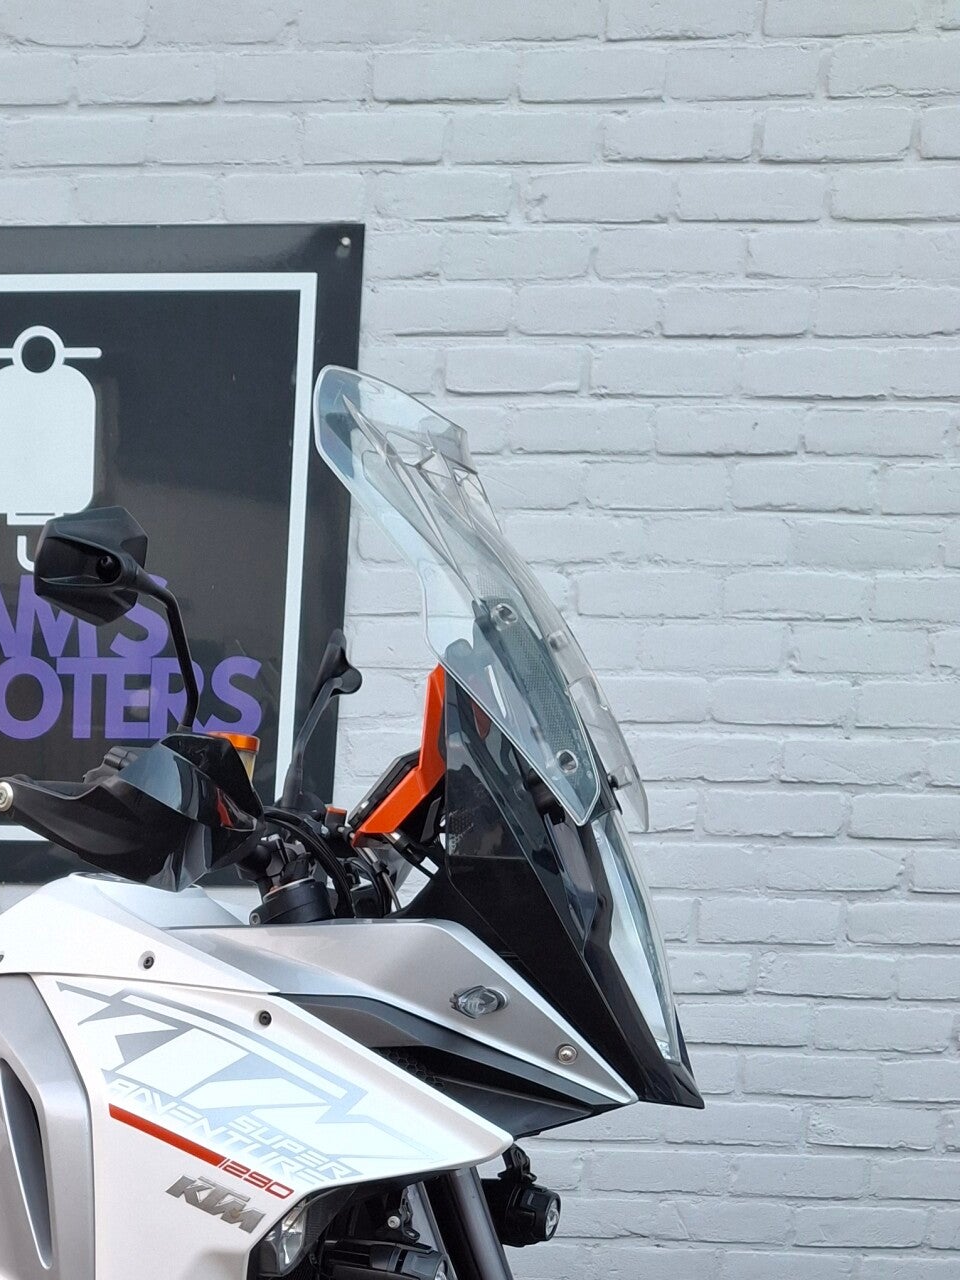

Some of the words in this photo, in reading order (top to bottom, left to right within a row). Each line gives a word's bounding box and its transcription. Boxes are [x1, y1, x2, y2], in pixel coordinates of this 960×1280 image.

[228, 1114, 355, 1181] SUPER
[165, 1174, 267, 1234] KTM
[218, 1158, 295, 1200] 1290
